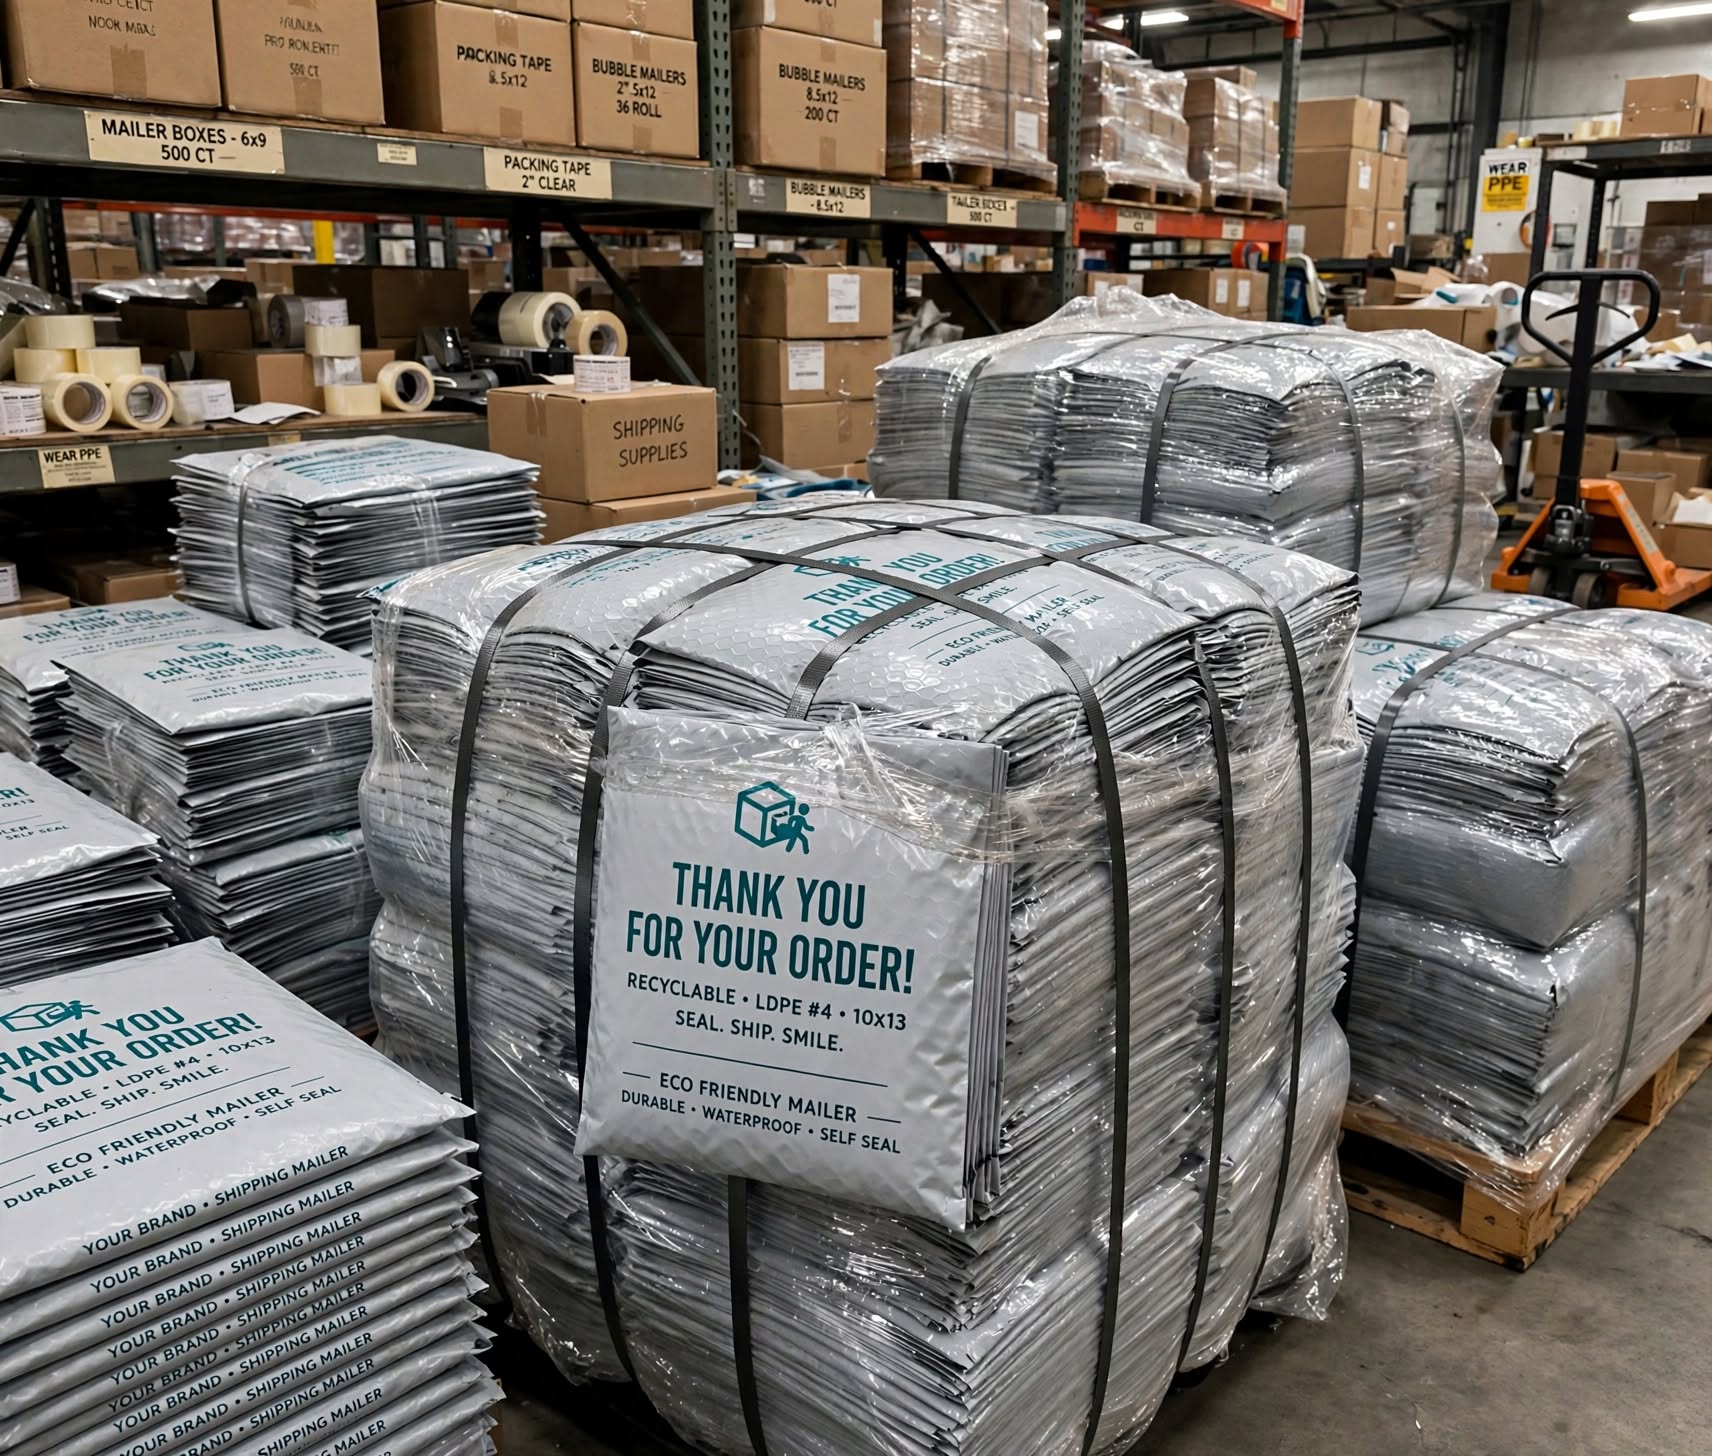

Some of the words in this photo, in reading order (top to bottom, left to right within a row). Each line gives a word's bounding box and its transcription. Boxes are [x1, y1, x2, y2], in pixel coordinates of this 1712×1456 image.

[457, 45, 517, 67] PACKING
[520, 54, 552, 72] TAPE
[592, 58, 637, 79] BUBBLE
[640, 66, 687, 86] MAILERS
[779, 63, 820, 84] BUBBLE
[823, 72, 865, 91] MAILERS
[616, 100, 630, 114] 36
[632, 102, 662, 118] ROLL
[805, 106, 824, 121] 200
[826, 109, 839, 124] CT
[806, 87, 838, 104] 8.5x12
[102, 119, 167, 140] MAILER
[172, 124, 226, 144] BOXES
[241, 131, 267, 147] 6x9
[161, 144, 191, 161] 500
[195, 147, 215, 163] CT
[504, 155, 559, 174] PACKING
[562, 160, 591, 176] TAPE
[1488, 162, 1527, 175] WEAR
[538, 176, 576, 192] CLEAR
[791, 181, 826, 197] BUBBLE
[828, 185, 866, 200] MAILERS
[1488, 176, 1523, 192] PPE
[816, 199, 844, 213] 8.5x12
[612, 414, 685, 440] SHIPPING
[43, 449, 78, 463] WEAR
[79, 447, 102, 460] PPE
[618, 441, 688, 468] SUPPLIES
[882, 552, 943, 573] YOU
[918, 552, 1005, 586] ORDER!
[144, 666, 189, 681] FOR
[188, 655, 250, 671] YOUR
[158, 650, 238, 667] THANK
[238, 643, 284, 656] YOU
[672, 861, 785, 920] THANK
[796, 877, 866, 930] YOU
[626, 910, 683, 960] FOR
[693, 920, 778, 976] YOUR
[788, 934, 915, 994] ORDER!
[627, 972, 736, 1006] RECYCLABLE
[756, 993, 802, 1015] LDPE
[808, 1001, 832, 1020] #4
[853, 1008, 907, 1031] 10x13
[0, 1028, 104, 1075] HANK
[101, 1005, 186, 1040] YOU
[675, 1010, 724, 1033] SEAL.
[730, 1019, 775, 1042] SHIP.
[782, 1027, 844, 1052] SMILE.
[12, 1050, 126, 1093] YOUR
[124, 1012, 263, 1060] ORDER!
[0, 1089, 97, 1125] YCLABLE
[115, 1066, 169, 1088] LDPE
[175, 1055, 200, 1070] #4
[218, 1035, 276, 1057] 10x13
[34, 1110, 96, 1133] SEAL.
[100, 1088, 157, 1113] SHIP.
[162, 1065, 229, 1093] SMILE.
[660, 1072, 693, 1093] ECO
[699, 1080, 782, 1110] FRIENDLY
[788, 1097, 857, 1123] MAILER
[46, 1152, 93, 1176] ECO
[98, 1113, 199, 1156] FRIENDLY
[205, 1086, 285, 1121] MAILER
[621, 1089, 686, 1115] DURABLE
[702, 1105, 802, 1136] WATERPROOF
[820, 1127, 856, 1147] SELF
[861, 1135, 900, 1154] SEAL
[5, 1168, 97, 1209] DURABLE
[113, 1117, 238, 1167] WATERPROOF
[254, 1100, 296, 1120] SELF
[299, 1084, 343, 1105] SEAL
[82, 1226, 134, 1256] YOUR
[137, 1202, 197, 1238] BRAND
[214, 1167, 289, 1207] SHIPPING
[292, 1145, 349, 1180] MAILER
[90, 1264, 141, 1295] YOUR
[144, 1240, 203, 1279] BRAND
[221, 1203, 296, 1242] SHIPPING
[299, 1179, 356, 1212] MAILER
[100, 1298, 151, 1330] YOUR
[155, 1272, 213, 1306] BRAND
[230, 1235, 305, 1275] SHIPPING
[307, 1210, 363, 1244] MAILER
[107, 1329, 157, 1359] YOUR
[160, 1301, 218, 1337] BRAND
[235, 1261, 308, 1302] SHIPPING
[310, 1235, 366, 1269] MAILER
[110, 1355, 161, 1386] YOUR
[164, 1326, 220, 1363] BRAND
[237, 1285, 309, 1328] SHIPPING
[311, 1260, 366, 1294] MAILER
[107, 1383, 156, 1413] YOUR
[160, 1351, 218, 1387] BRAND
[235, 1308, 307, 1350] SHIPPING
[311, 1281, 366, 1316] MAILER
[113, 1403, 162, 1434] YOUR
[167, 1374, 223, 1412] BRAND
[239, 1333, 311, 1373] SHIPPING
[314, 1305, 368, 1339] MAILER
[172, 1403, 229, 1439] BRAND
[246, 1359, 317, 1402] SHIPPING
[319, 1332, 373, 1366] MAILER
[179, 1430, 233, 1456] RAND
[250, 1386, 319, 1429] SHIPPING
[322, 1358, 375, 1393] MAILER
[258, 1416, 328, 1456] SHIPPING
[330, 1388, 383, 1423] MAILER
[334, 1420, 387, 1456] MAILER
